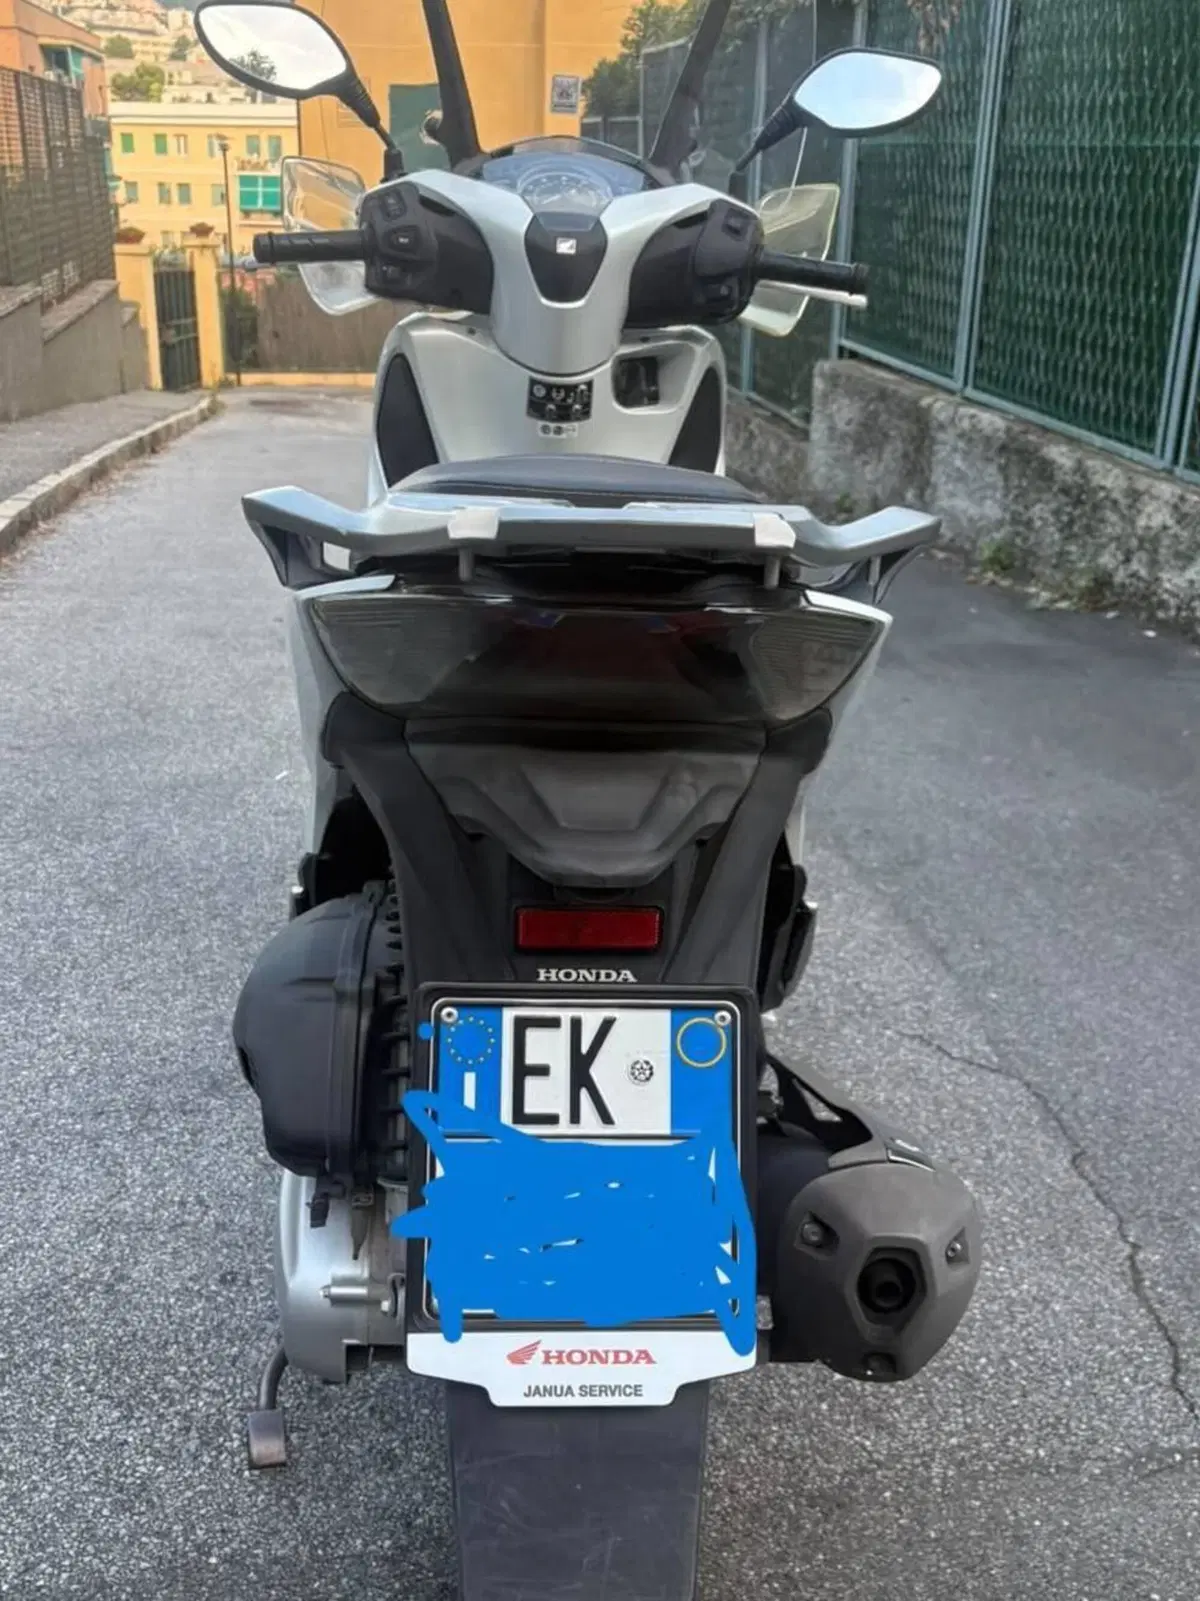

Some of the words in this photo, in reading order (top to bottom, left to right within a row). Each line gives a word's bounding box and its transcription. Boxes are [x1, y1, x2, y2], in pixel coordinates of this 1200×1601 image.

[536, 968, 638, 983] HONDA
[511, 1014, 618, 1126] EK
[541, 1349, 657, 1365] HONDA
[523, 1384, 576, 1398] JANUA
[579, 1384, 643, 1398] SERVICE
